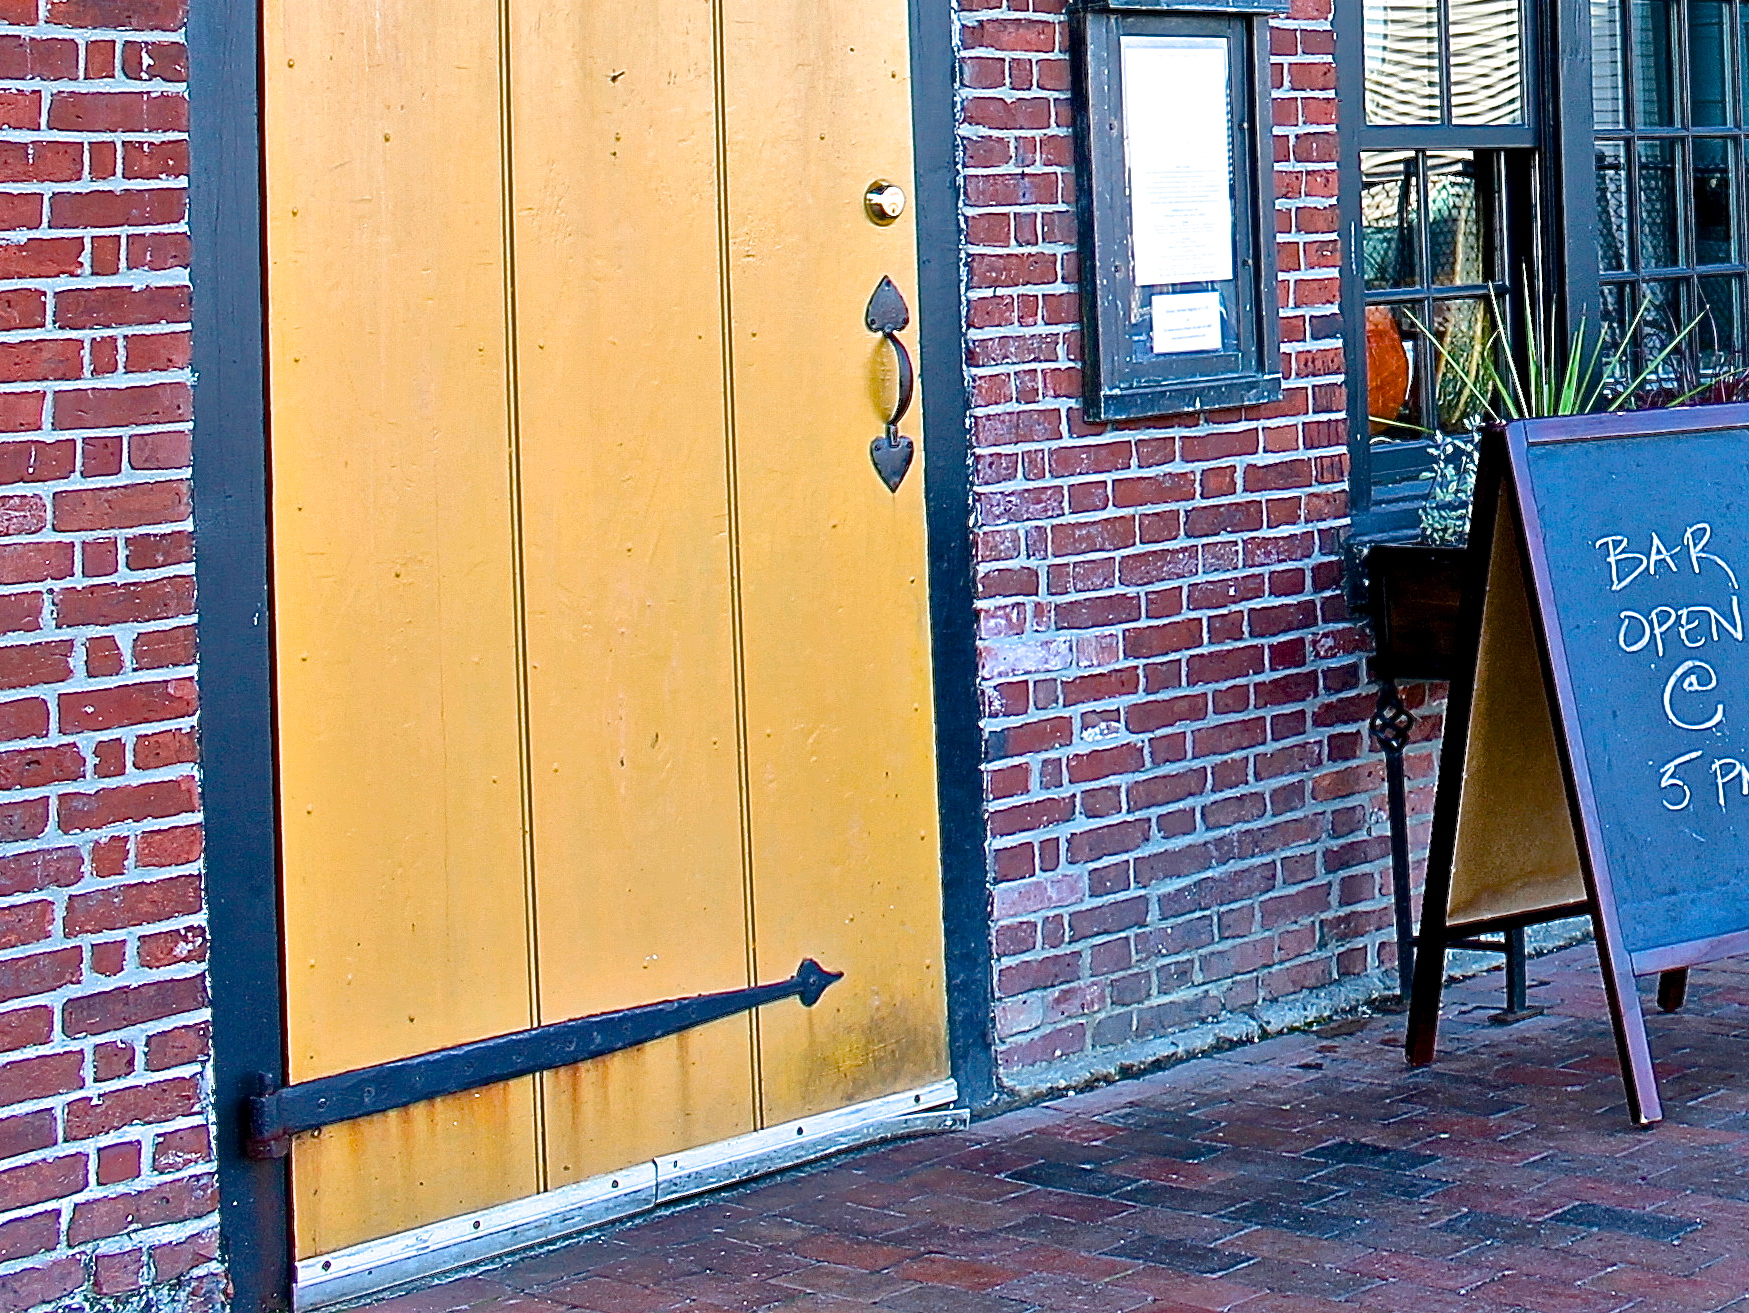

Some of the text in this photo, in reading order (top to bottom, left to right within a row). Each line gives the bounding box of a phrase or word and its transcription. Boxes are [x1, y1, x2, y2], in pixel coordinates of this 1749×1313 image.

[1594, 522, 1739, 592] BAR
[1618, 595, 1742, 657] OPEN
[1663, 660, 1724, 731] @
[1660, 751, 1703, 811] 5
